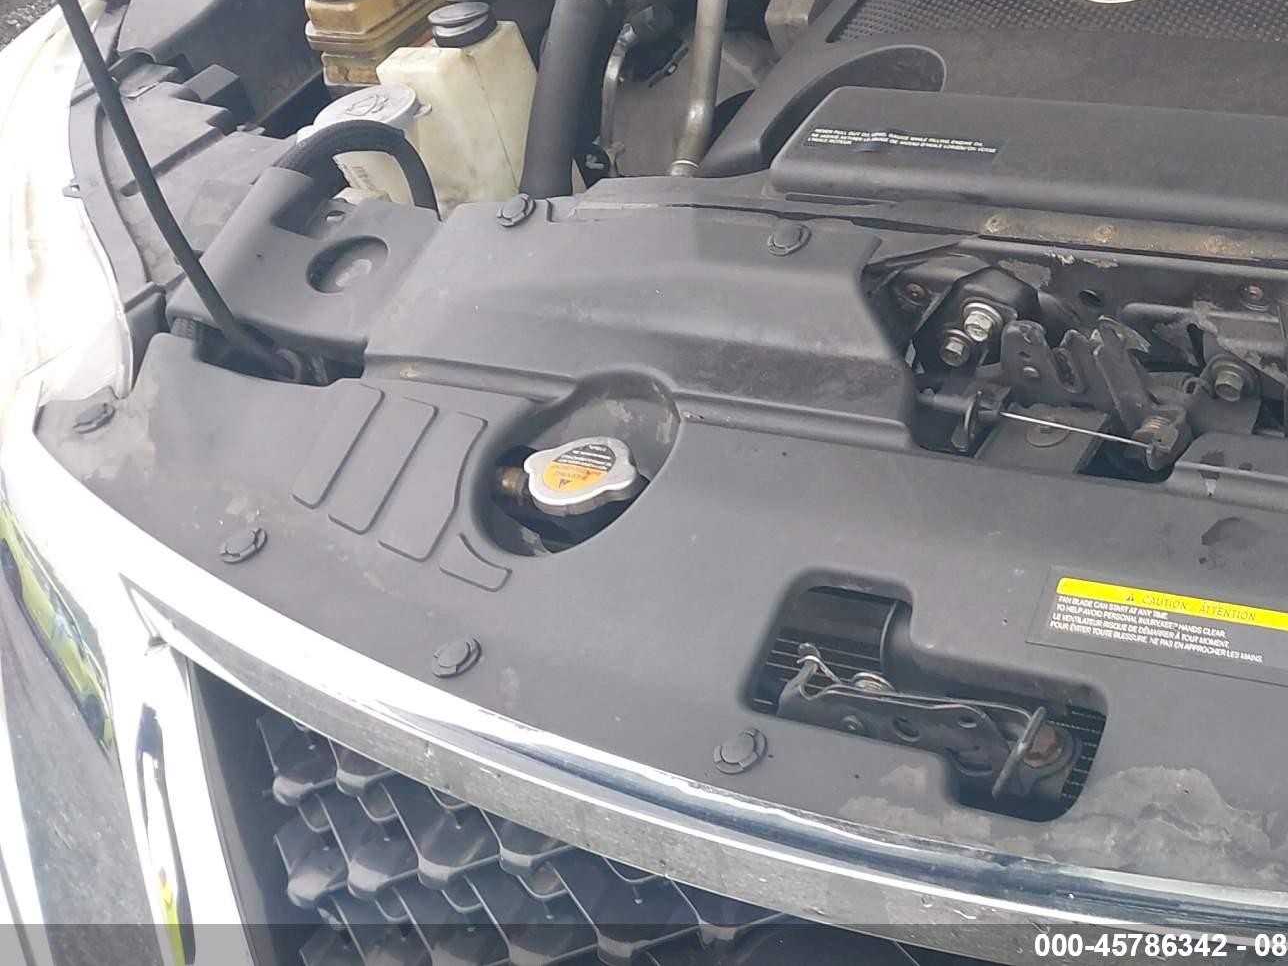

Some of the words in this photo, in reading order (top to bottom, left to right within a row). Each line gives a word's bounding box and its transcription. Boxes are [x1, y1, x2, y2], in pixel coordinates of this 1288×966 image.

[1056, 604, 1066, 612] TO
[1066, 605, 1083, 614] HELP
[1083, 608, 1103, 618] AVOID
[1103, 611, 1138, 623] PERSONAL
[1178, 624, 1202, 634] HANDS
[1093, 601, 1109, 610] CAN
[1137, 609, 1152, 617] ANY
[1142, 595, 1187, 610] CAUTION
[1200, 603, 1256, 621] ATTENTION
[1052, 613, 1062, 621] LE
[1128, 625, 1138, 633] DE
[1050, 621, 1069, 630] POUR
[1149, 637, 1159, 645] NE
[1159, 639, 1173, 647] PAS
[1227, 650, 1240, 659] LES
